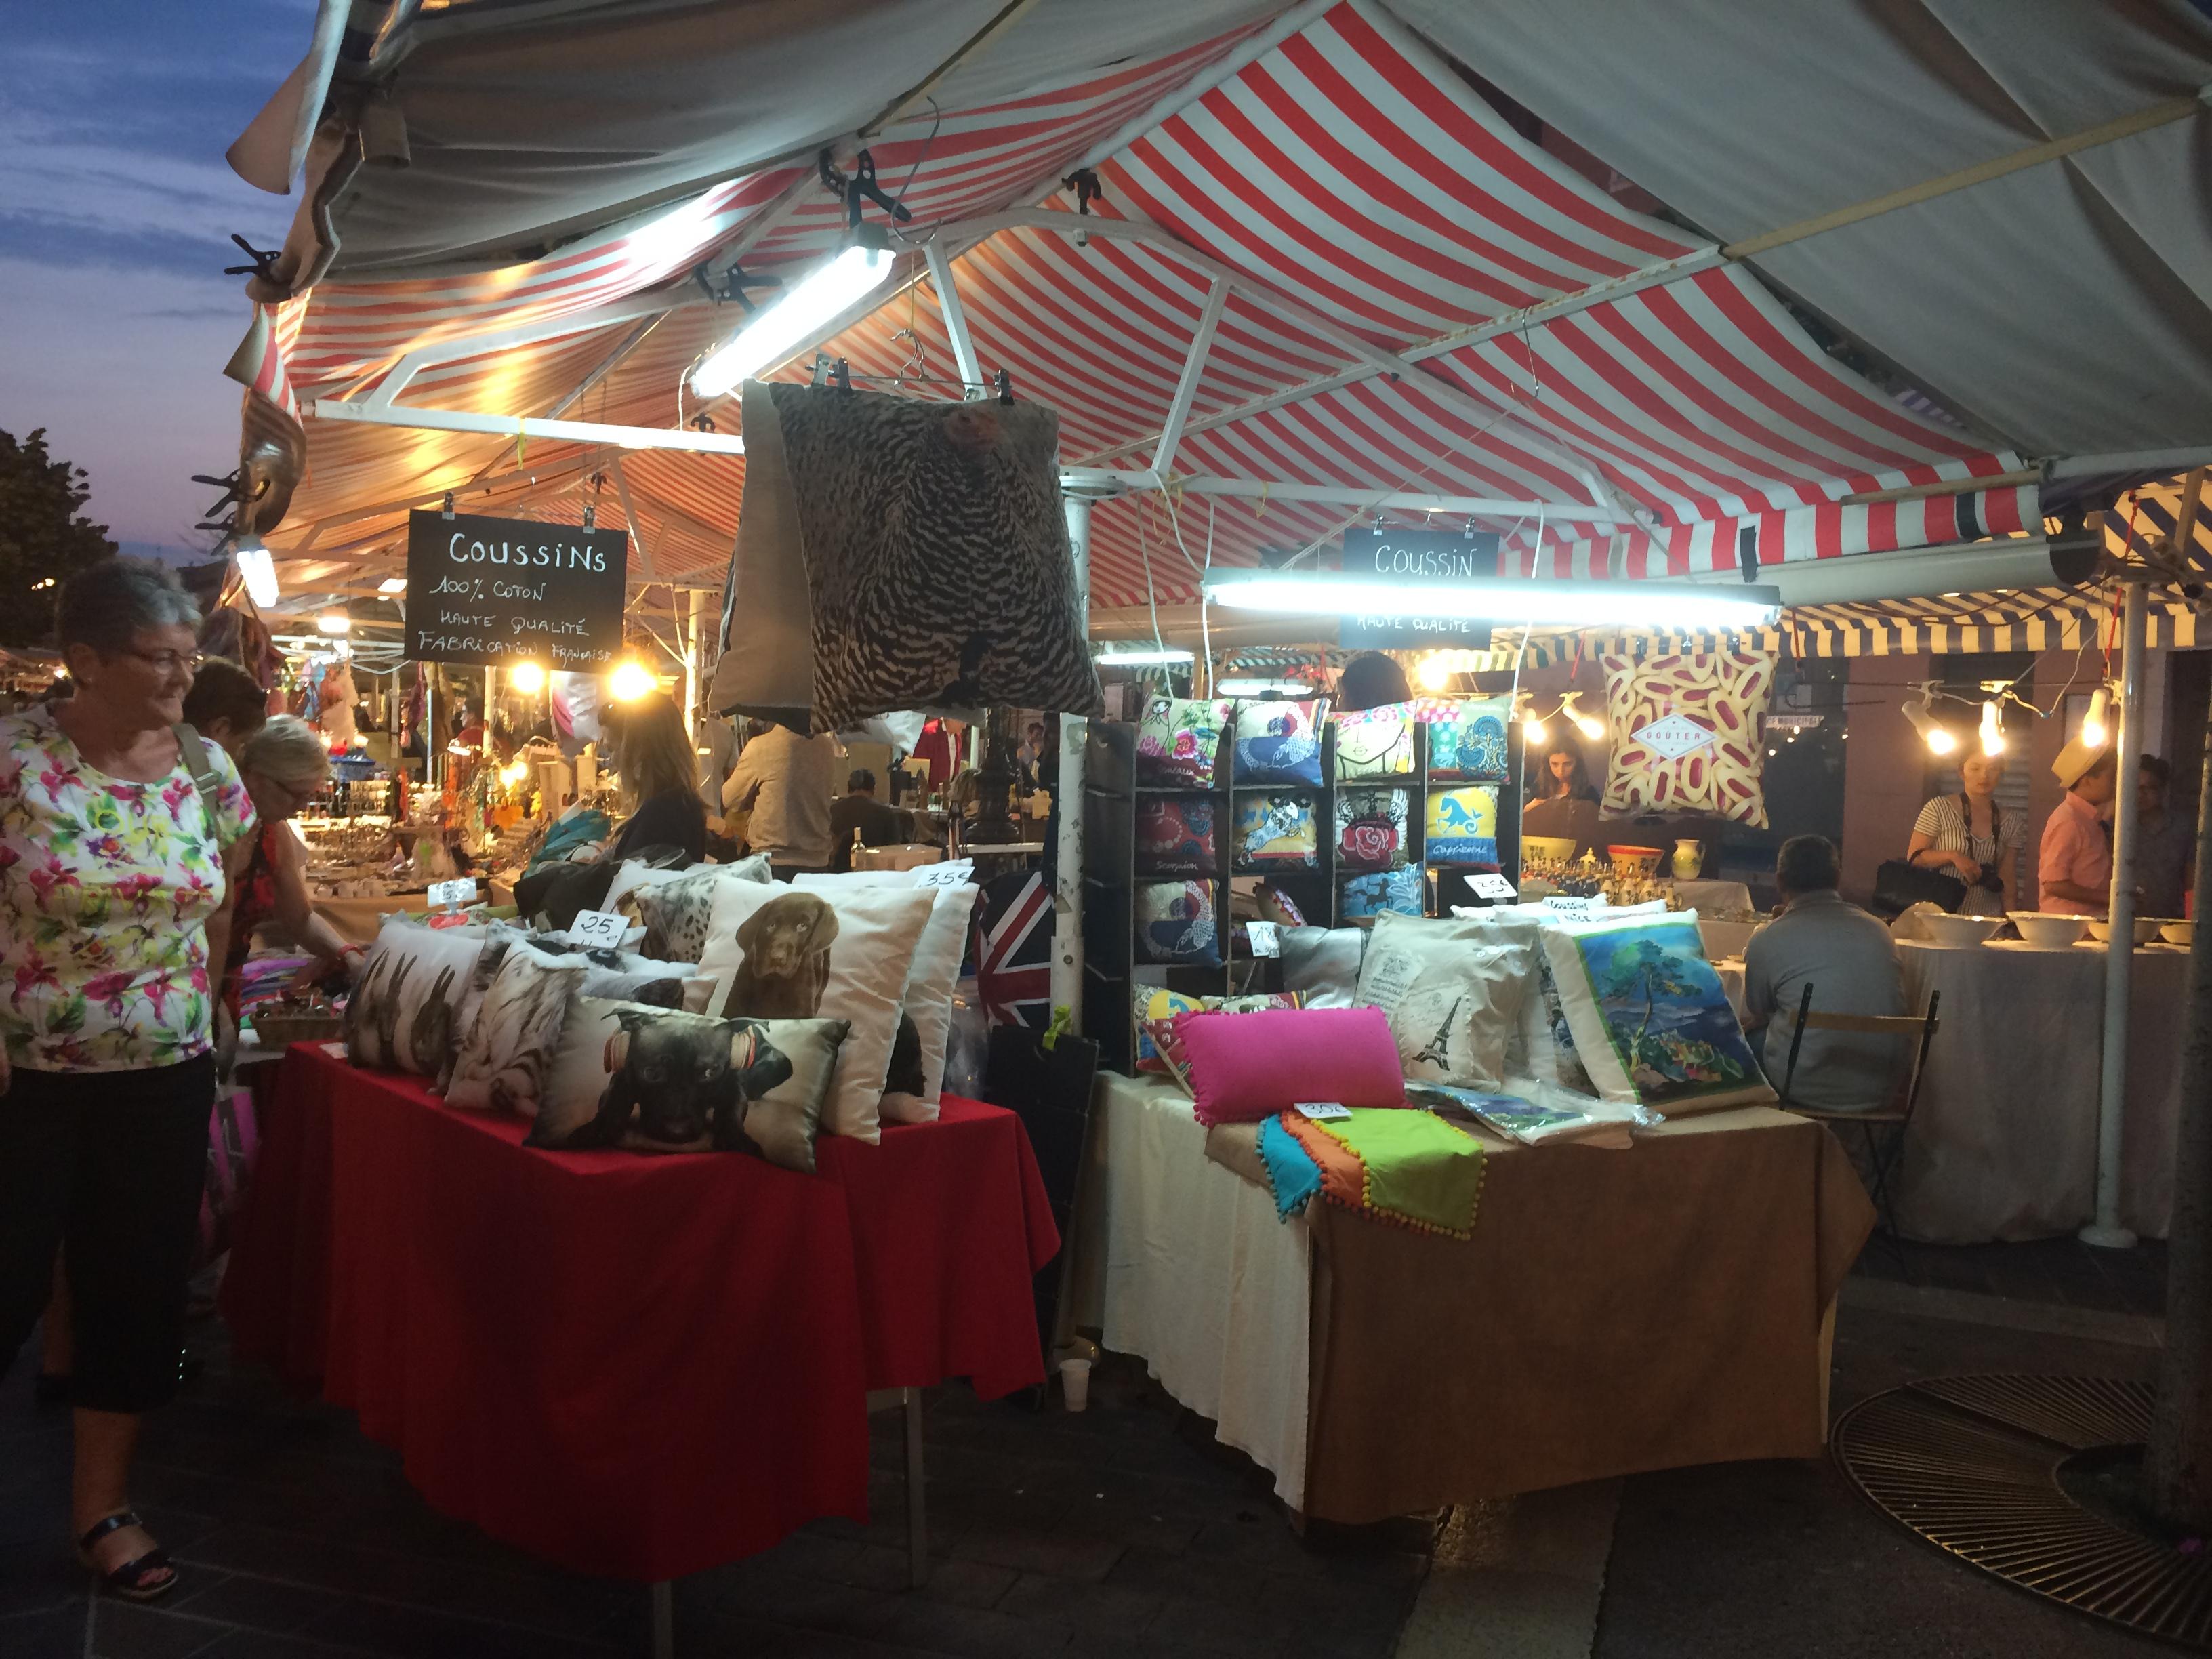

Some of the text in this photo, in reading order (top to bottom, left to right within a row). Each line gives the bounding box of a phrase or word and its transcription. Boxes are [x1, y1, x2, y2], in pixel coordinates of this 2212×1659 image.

[429, 575, 547, 602] 100% COTON
[441, 609, 497, 628] HAUTE
[1357, 615, 1404, 630] HAUTE
[417, 630, 539, 657] FABRICATION
[581, 916, 613, 934] 25
